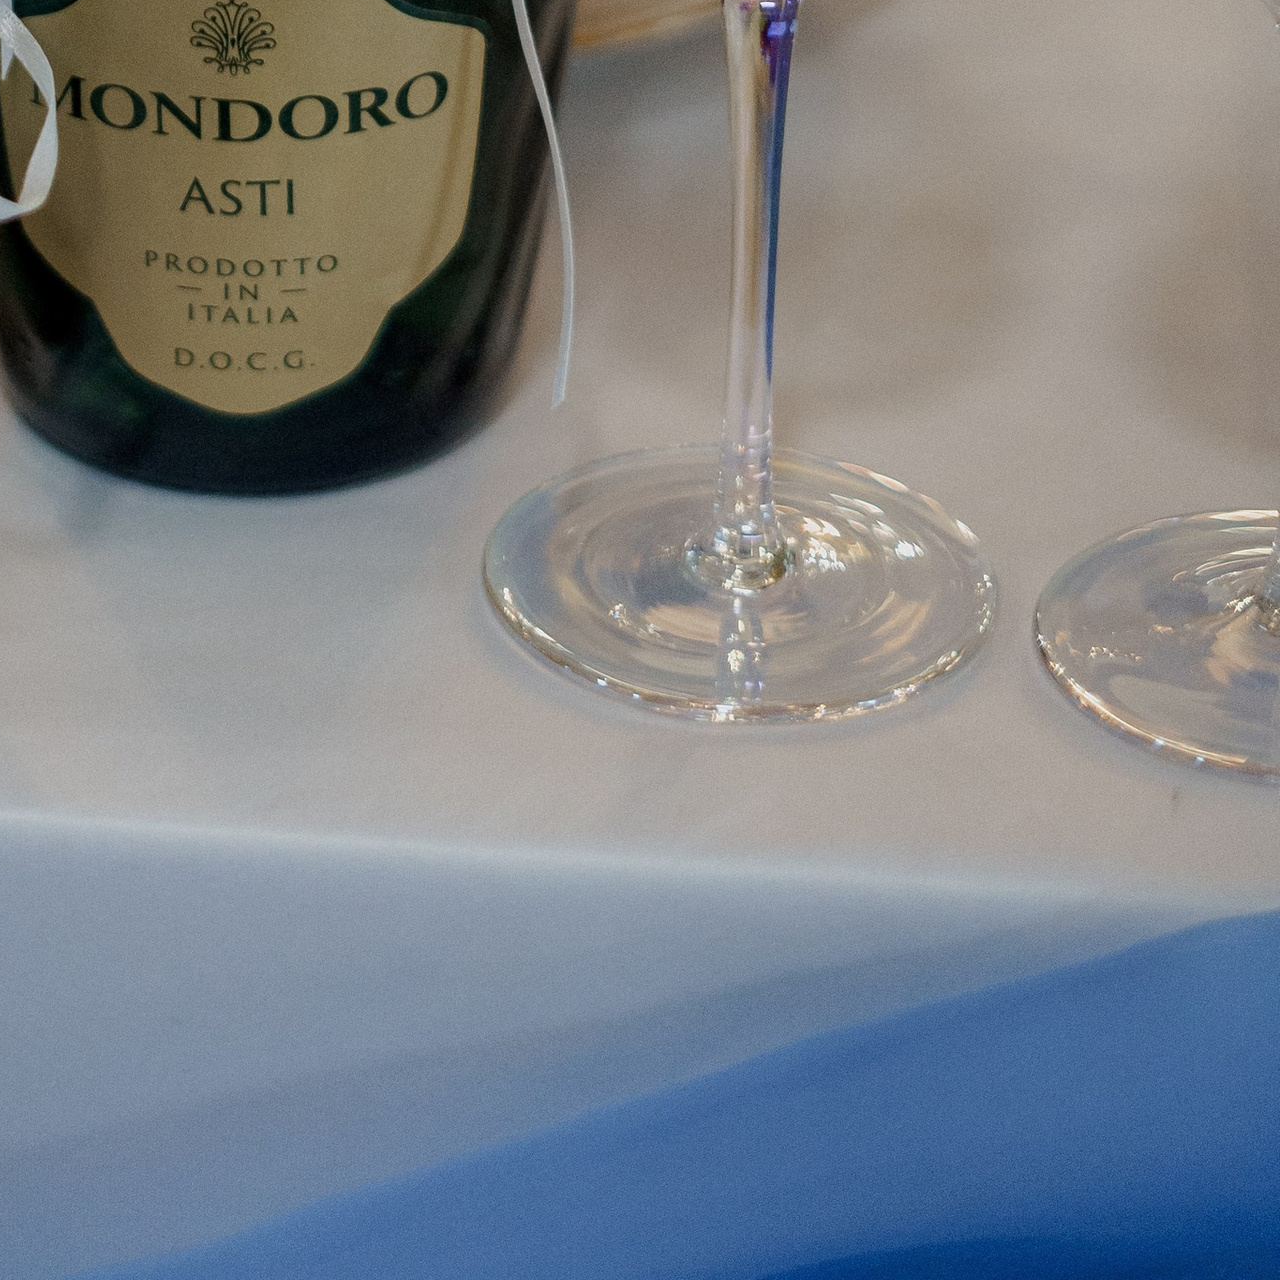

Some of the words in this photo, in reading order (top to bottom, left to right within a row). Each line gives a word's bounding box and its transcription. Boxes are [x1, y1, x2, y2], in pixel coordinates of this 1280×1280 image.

[30, 70, 449, 143] MONDORO
[178, 176, 296, 217] ASTI
[144, 248, 340, 278] PRODOTTO
[223, 283, 260, 301] IN
[188, 303, 300, 324] ITALIA
[173, 346, 316, 371] D.O.C.G.
